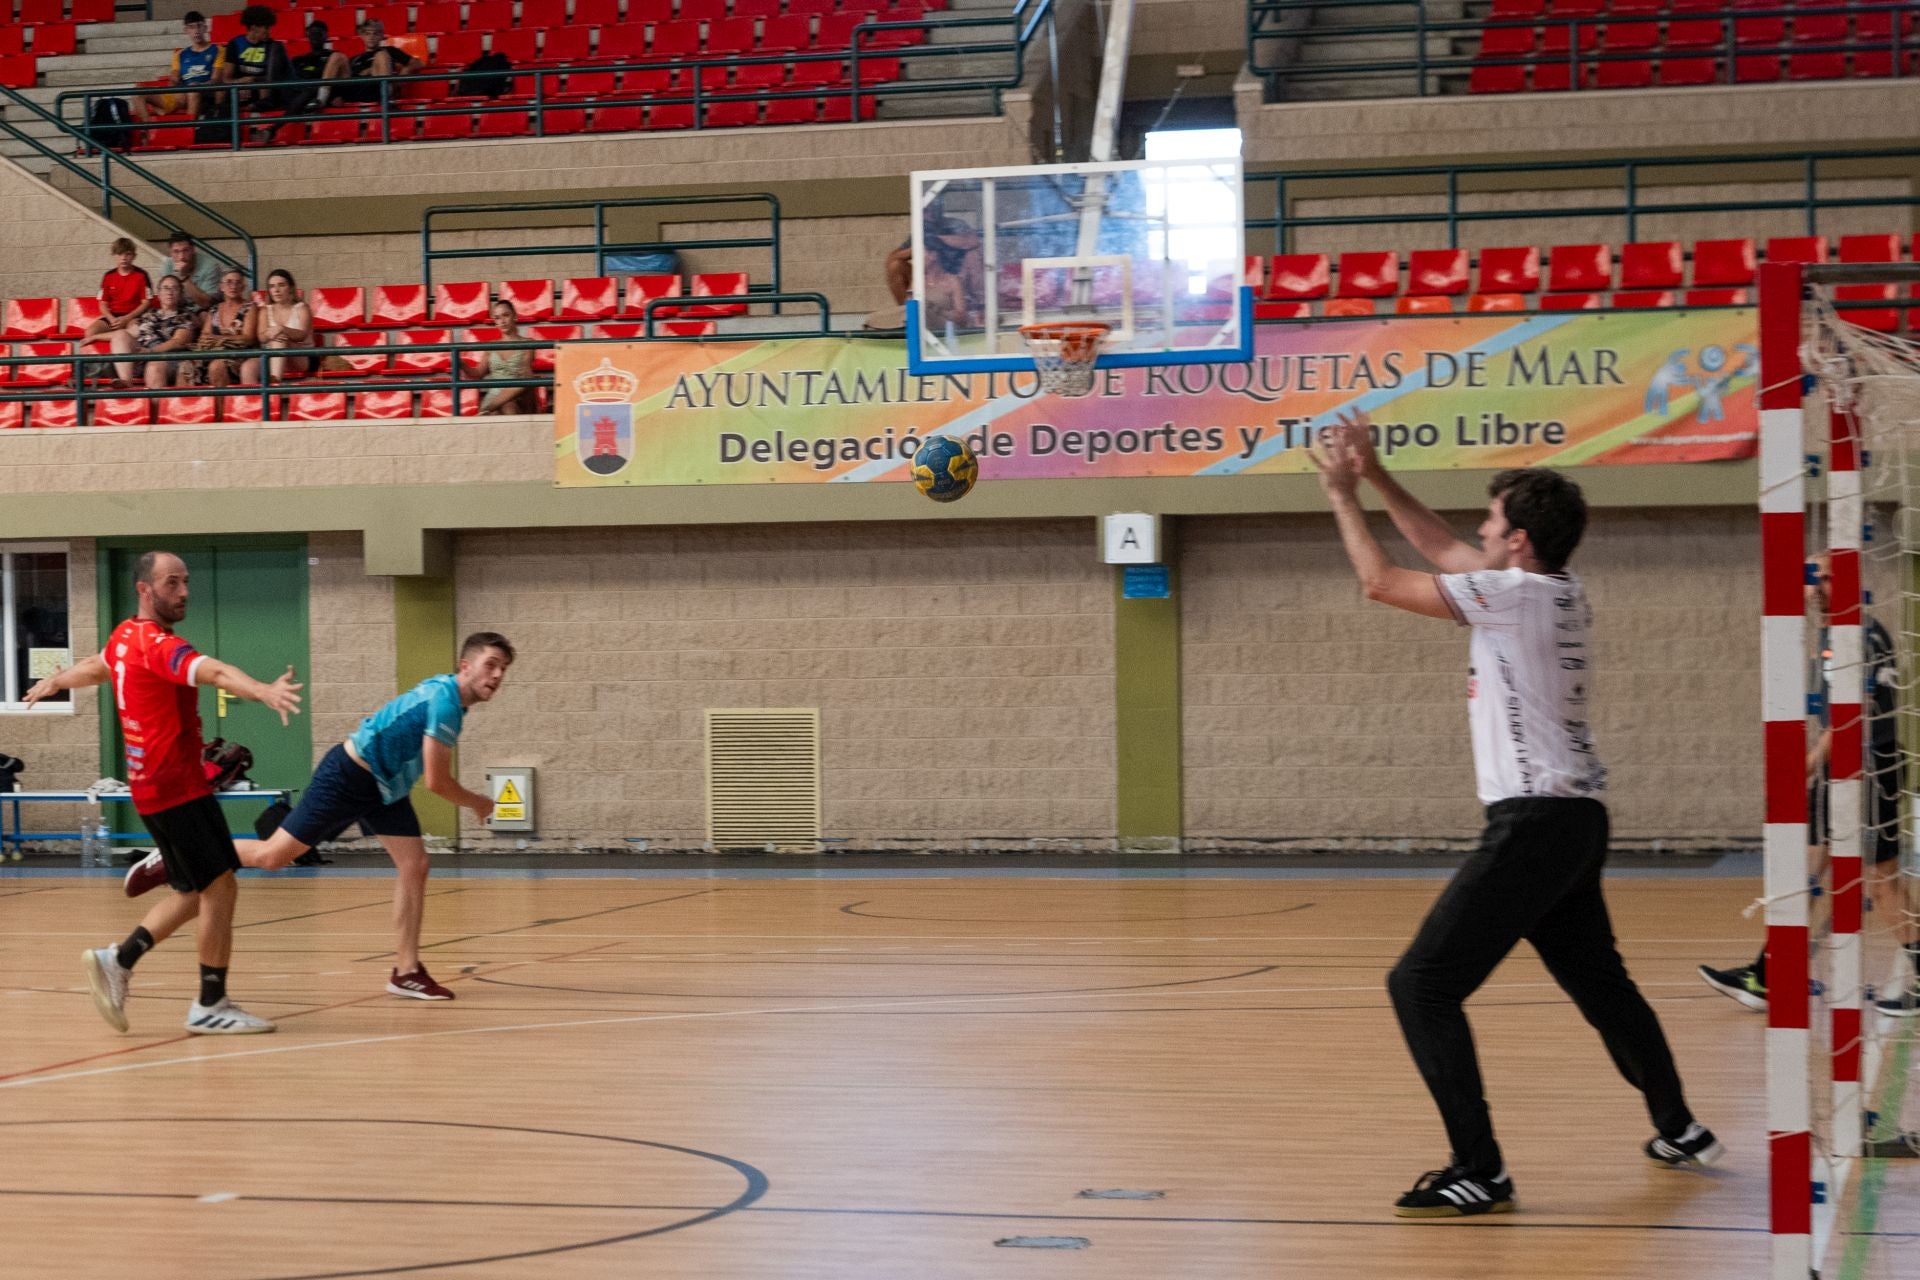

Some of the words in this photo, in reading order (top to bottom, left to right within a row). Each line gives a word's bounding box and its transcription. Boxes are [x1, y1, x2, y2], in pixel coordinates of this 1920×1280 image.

[239, 47, 265, 63] 46
[666, 368, 1041, 408] AYUNTAMIENTO
[1142, 351, 1404, 401] ROQUETAS
[1424, 351, 1487, 387] DE
[1507, 345, 1624, 387] MAR
[720, 427, 931, 470] Delegació
[966, 424, 1014, 457] de
[1030, 423, 1223, 462] Deportes
[1239, 426, 1263, 459] y
[1456, 413, 1566, 446] Libre
[1119, 526, 1140, 550] A
